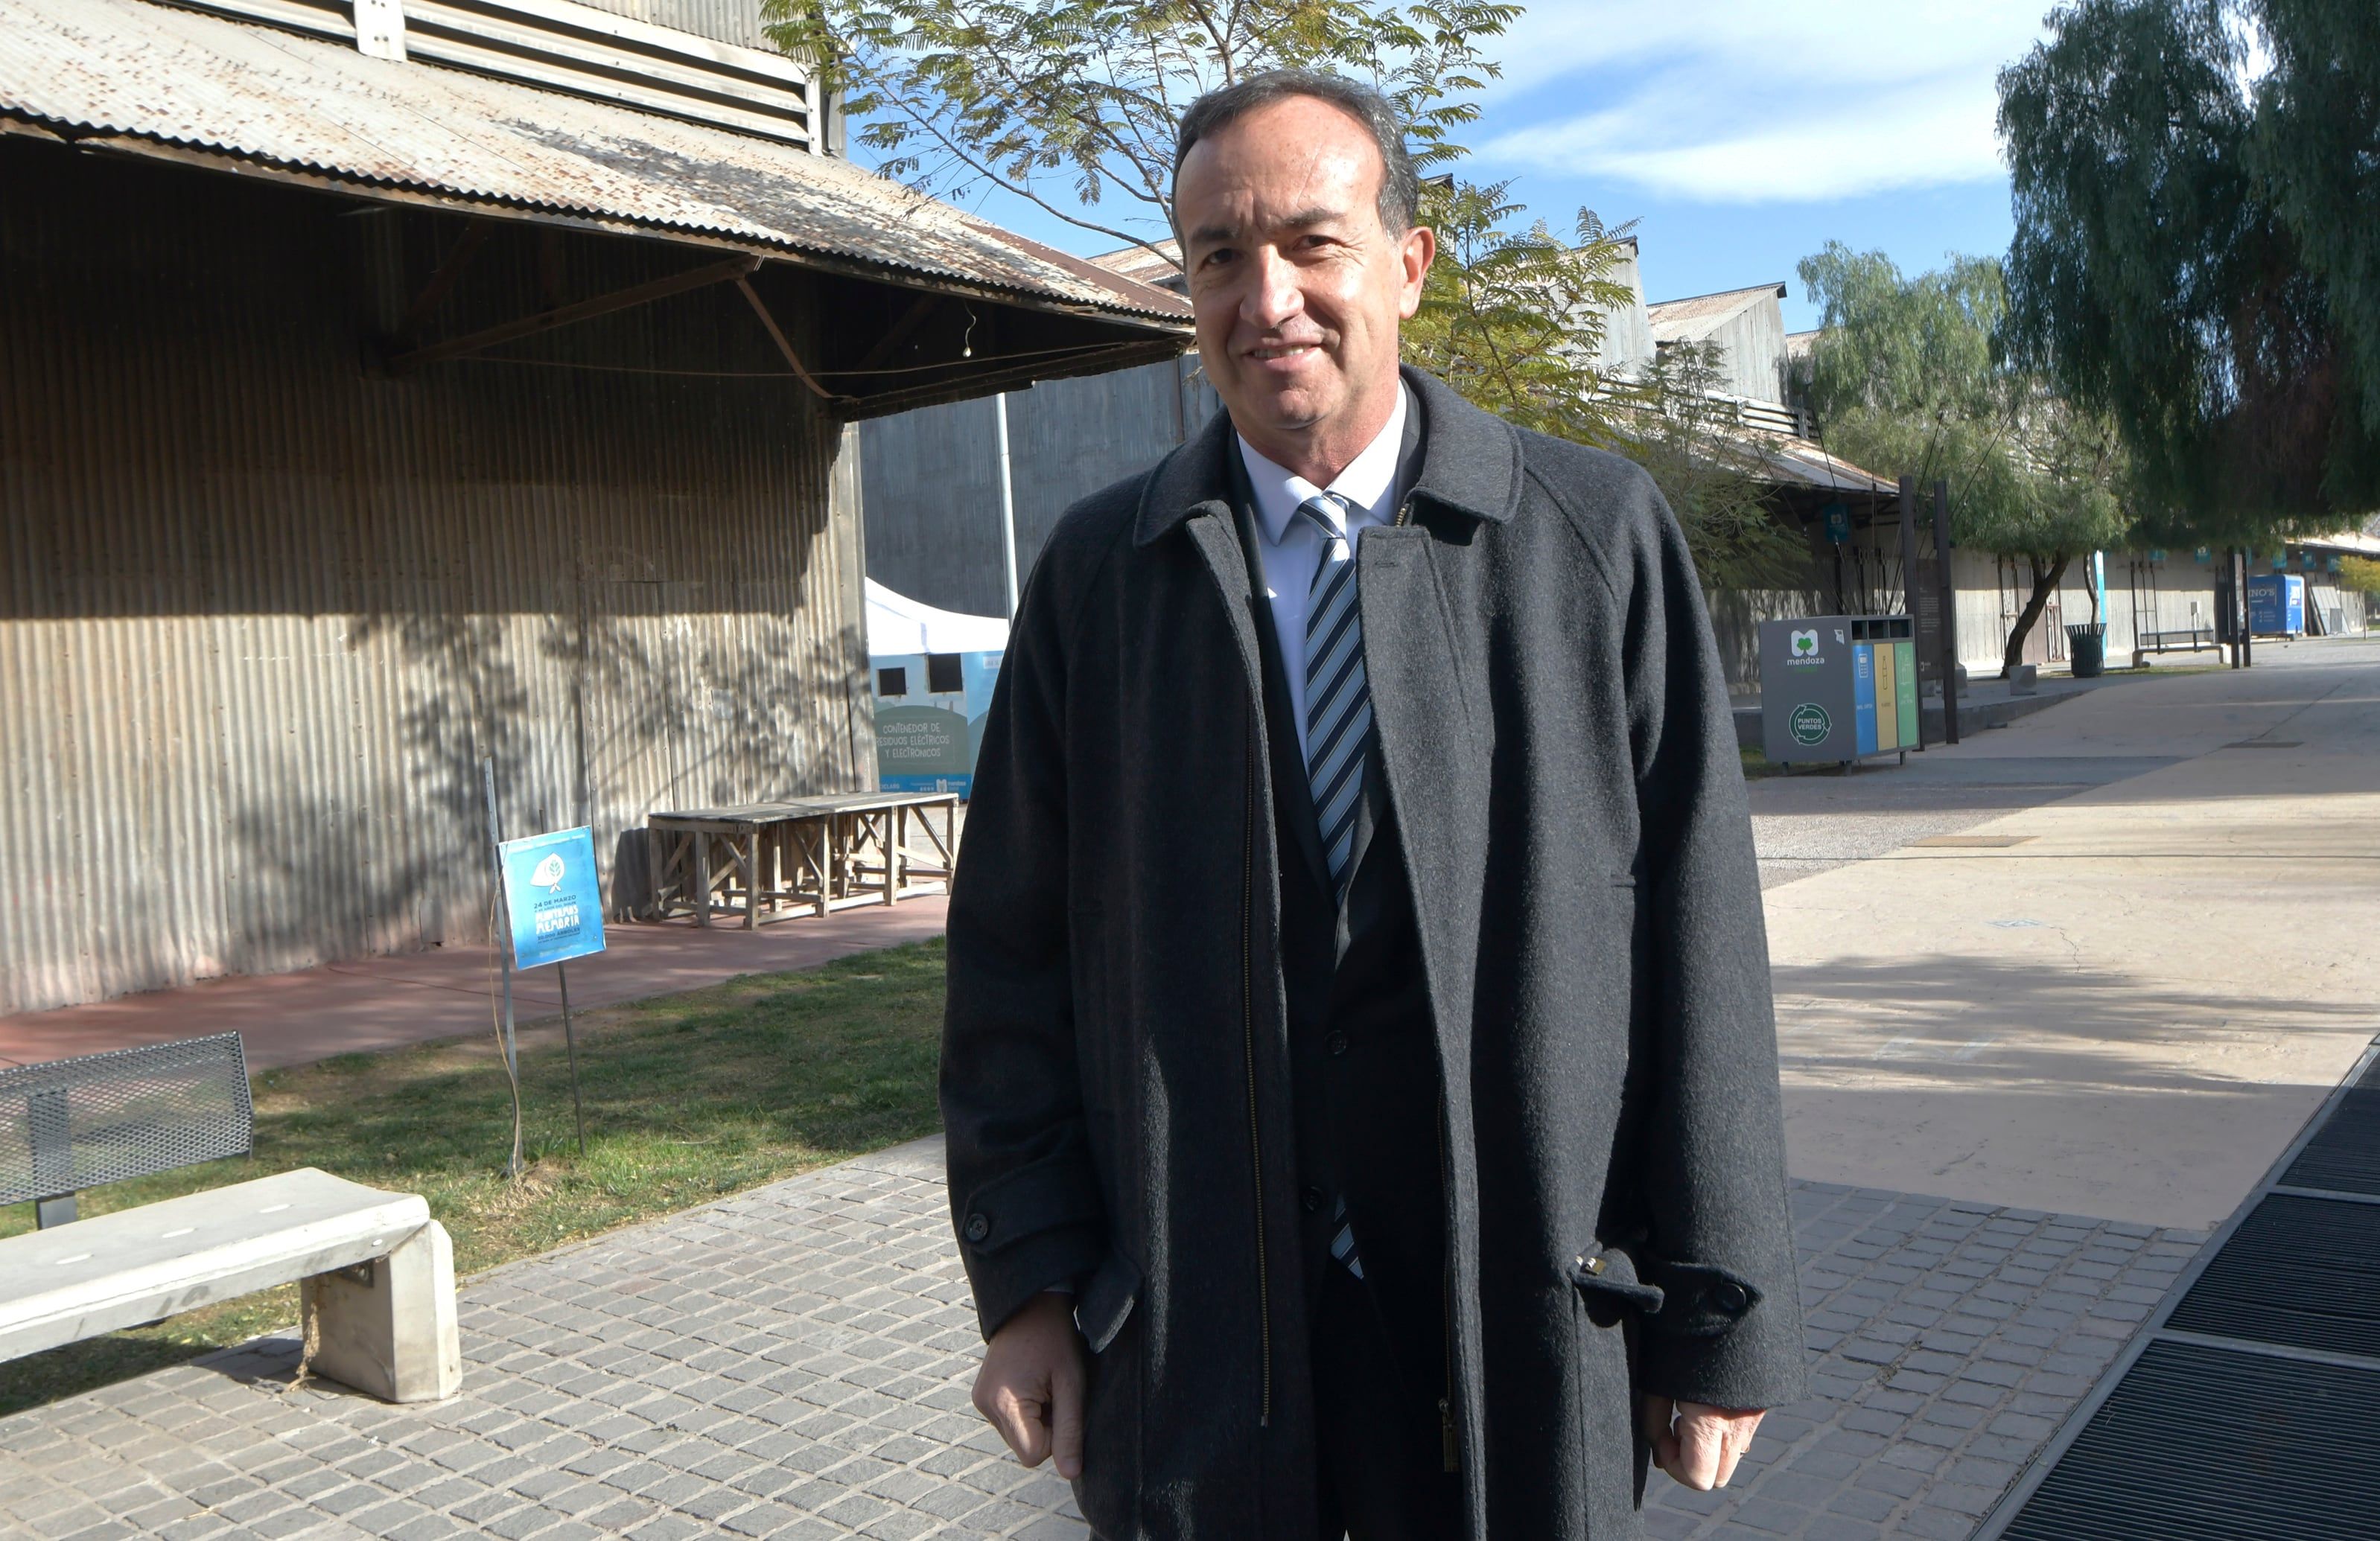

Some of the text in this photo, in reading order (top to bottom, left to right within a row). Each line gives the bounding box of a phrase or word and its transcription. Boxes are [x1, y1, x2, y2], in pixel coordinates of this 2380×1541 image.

[1787, 656, 1824, 666] mendoza
[882, 723, 941, 734] CONTENEDOR DE
[910, 733, 950, 746] ELÉCTRICOS
[885, 749, 890, 758] Y
[554, 895, 576, 904] MARZO
[536, 914, 580, 934] MEMORIA
